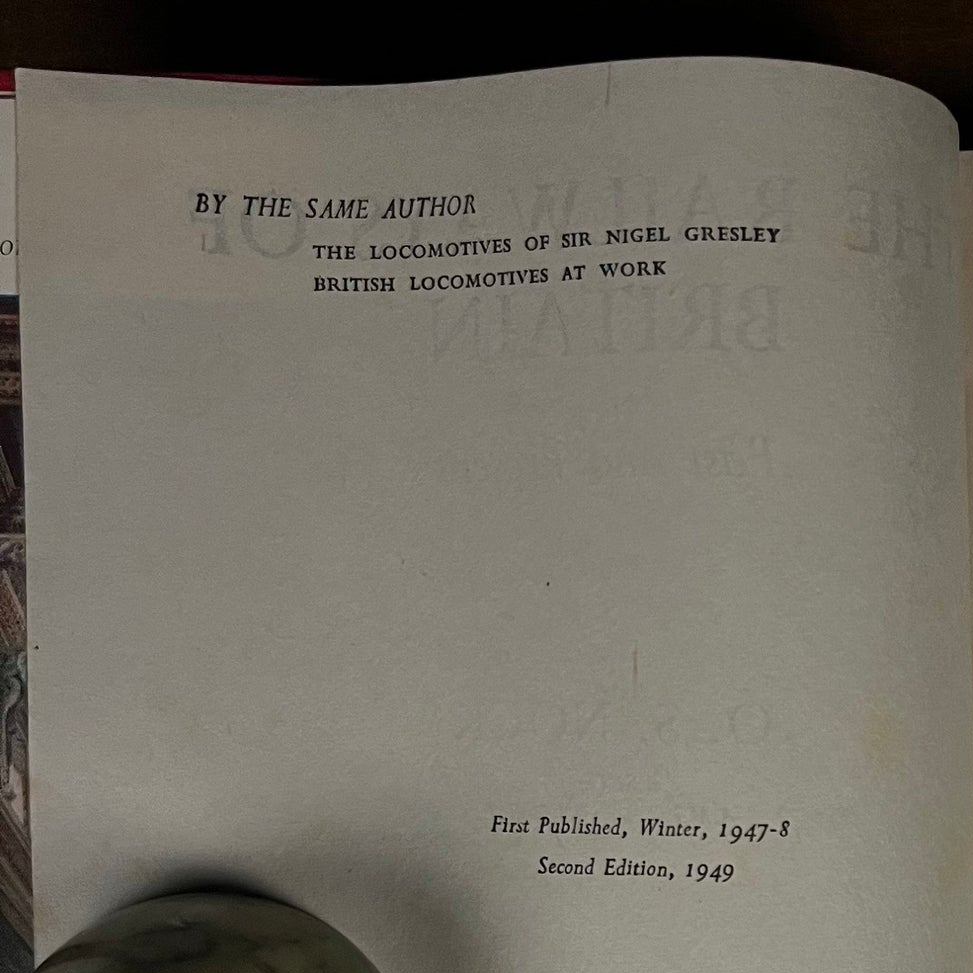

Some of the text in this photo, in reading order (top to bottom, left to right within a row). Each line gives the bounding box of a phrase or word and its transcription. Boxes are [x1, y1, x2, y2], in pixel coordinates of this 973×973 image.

[195, 193, 475, 219] BY THE SAME AUTHOR
[312, 227, 780, 260] THE LOCOMOTIVES OF SIR NIGEL GRESLEY
[314, 261, 666, 292] BRITISH LOCOMOTIVES AT WORK
[491, 815, 790, 844] First Published, Winter, 1947-8
[538, 856, 734, 882] Second Edition, 1949
